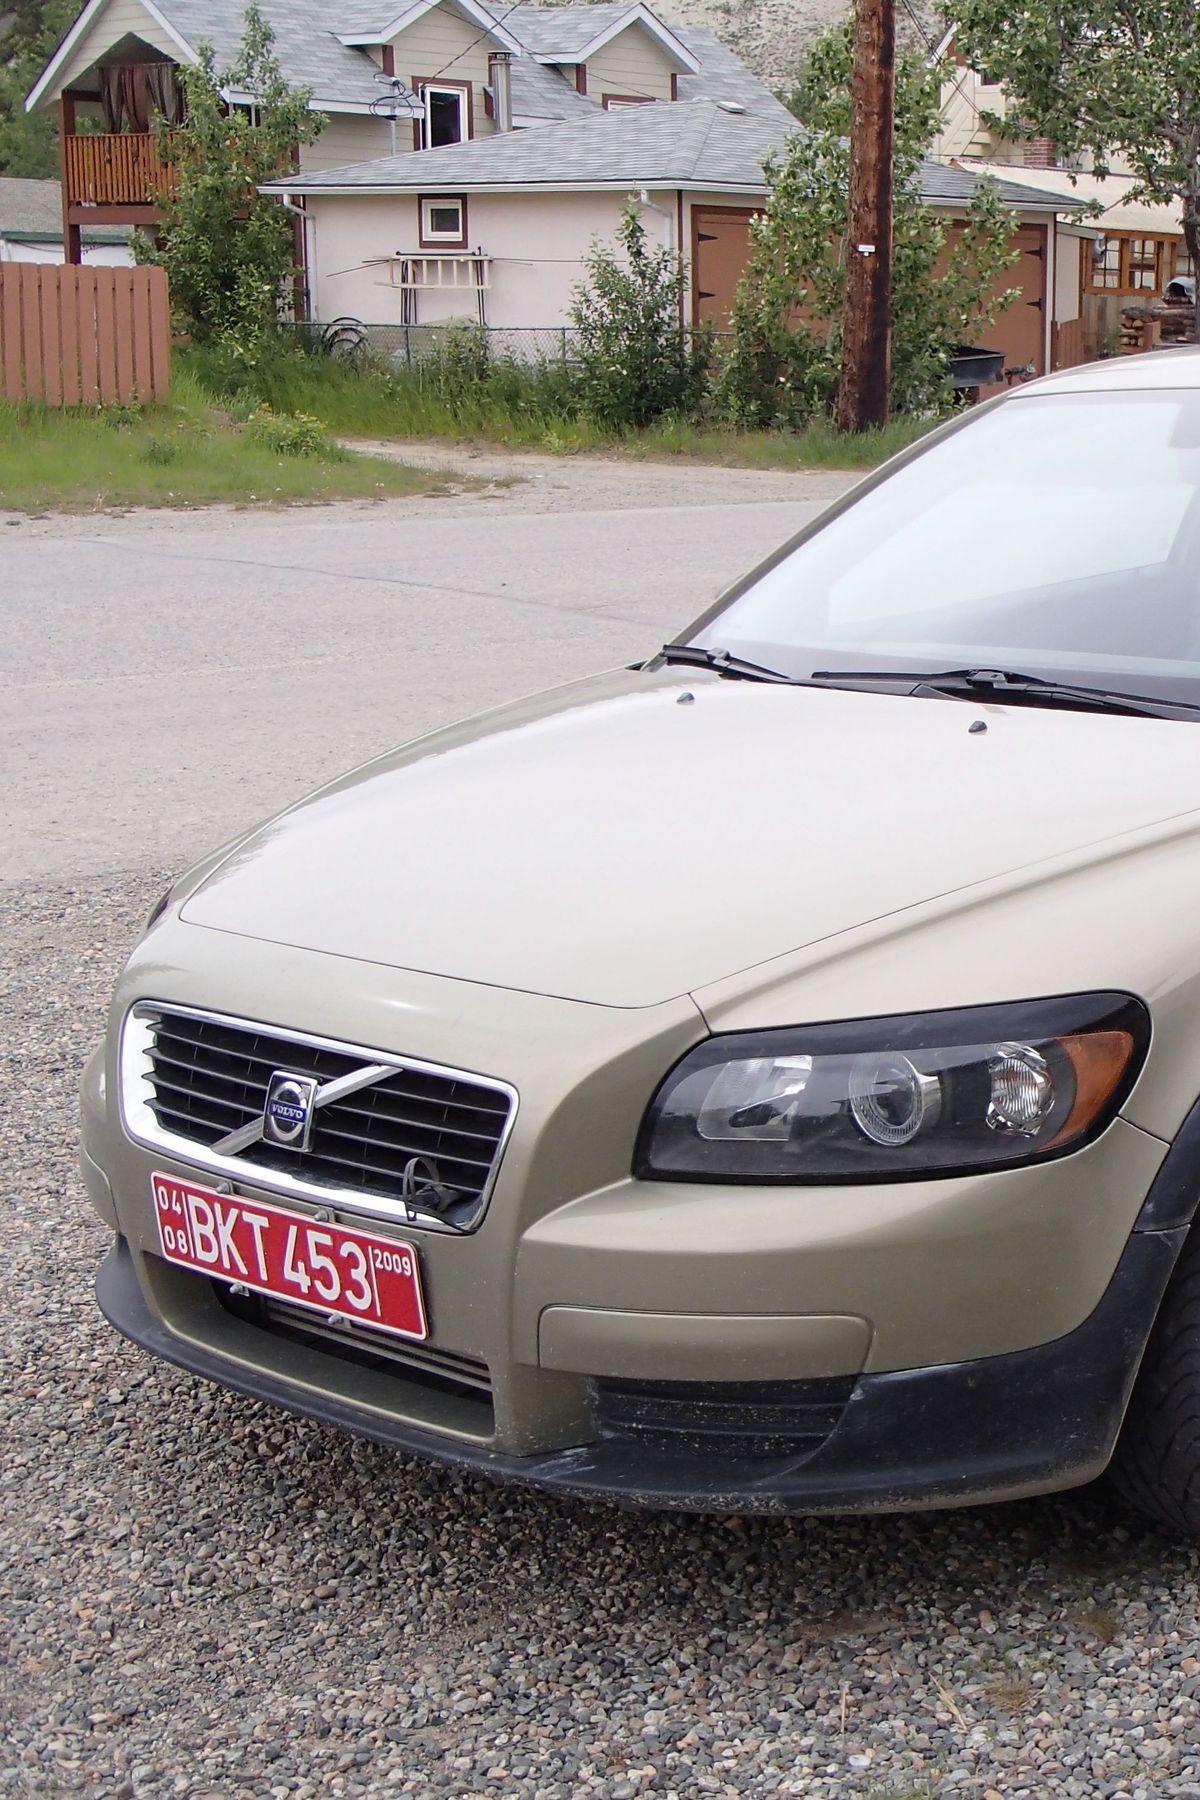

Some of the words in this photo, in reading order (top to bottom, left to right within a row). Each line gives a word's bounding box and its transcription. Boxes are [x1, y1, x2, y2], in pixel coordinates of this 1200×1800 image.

[271, 1103, 304, 1119] VOLVO
[157, 1185, 182, 1215] 04
[164, 1227, 188, 1255] 08
[187, 1194, 270, 1281] BKT
[283, 1225, 372, 1311] 453
[374, 1249, 412, 1277] 2009
